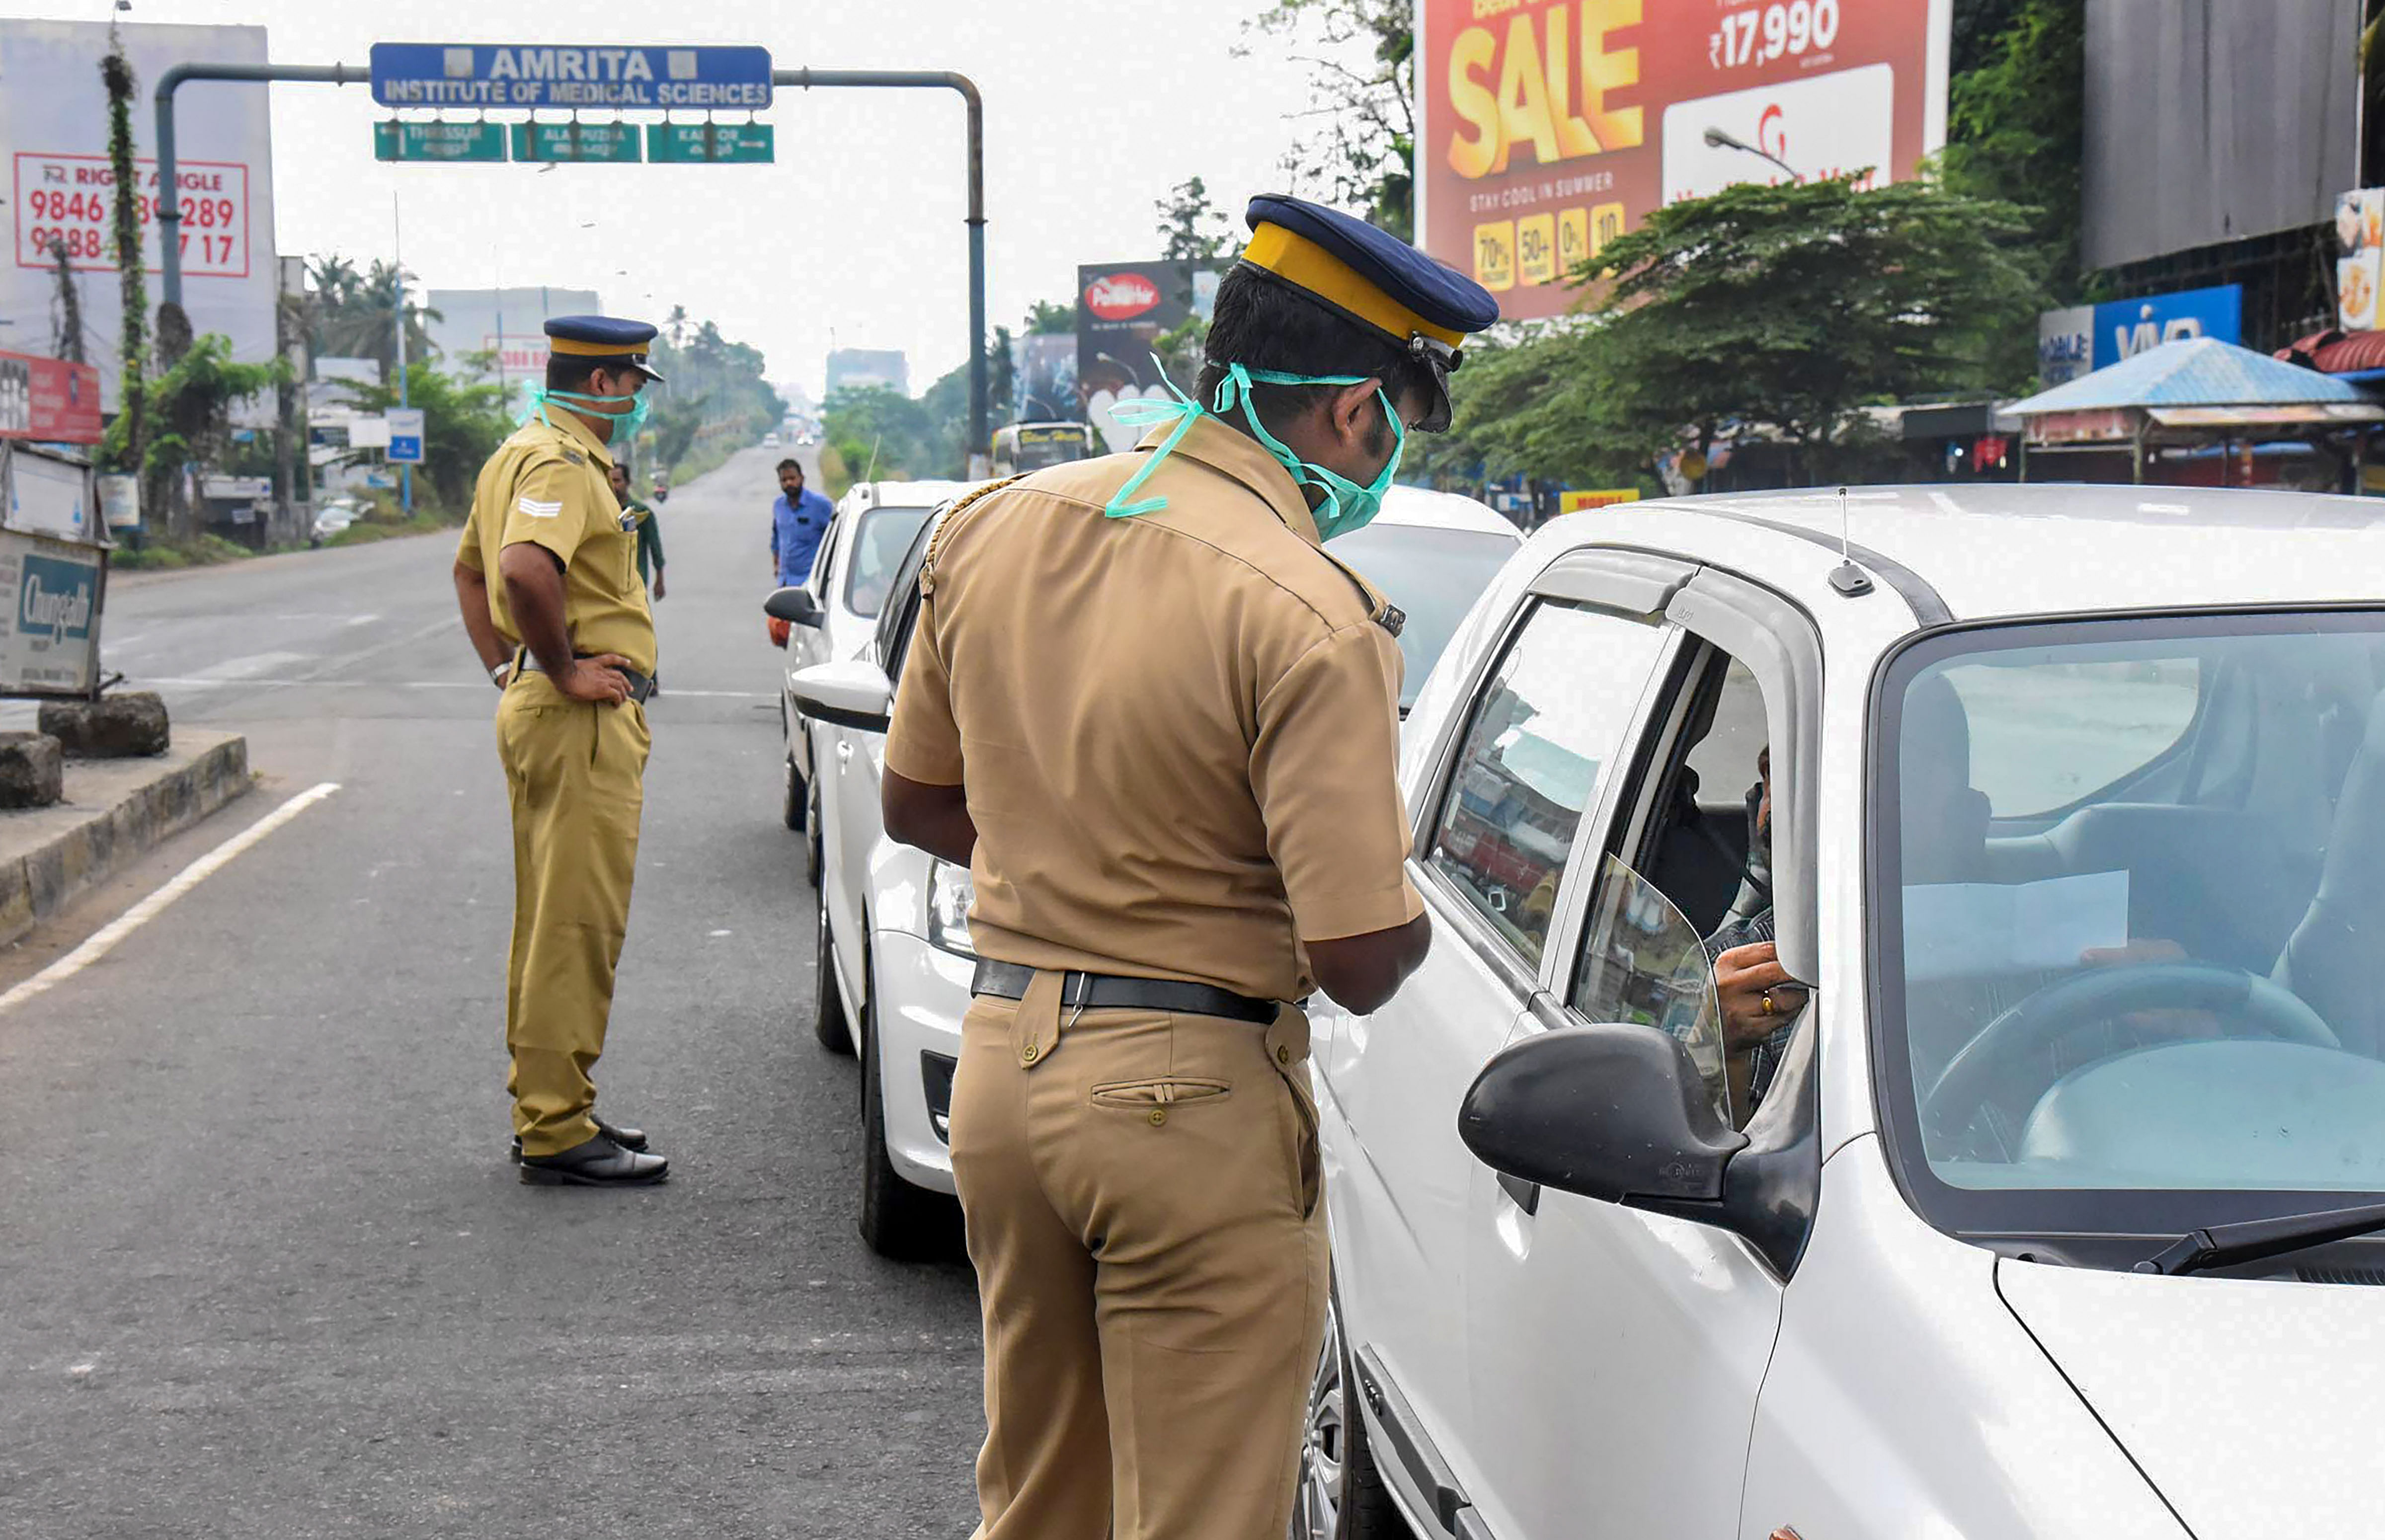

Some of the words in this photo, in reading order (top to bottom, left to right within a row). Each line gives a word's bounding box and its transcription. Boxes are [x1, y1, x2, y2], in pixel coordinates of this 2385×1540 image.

[489, 49, 654, 80] AMRITA
[384, 80, 506, 102] INSTITUTE
[511, 81, 542, 102] OF
[549, 82, 651, 103] MEDICAL
[657, 83, 767, 104] SCIENCES
[1447, 0, 1644, 178] SALE
[76, 167, 143, 187] RIGT
[148, 172, 223, 191] AGLE
[1469, 193, 1498, 212] STAY
[1501, 186, 1536, 208] COOL
[1538, 182, 1553, 198] IN
[1555, 171, 1613, 198] SUMMER
[29, 190, 104, 222] 9846
